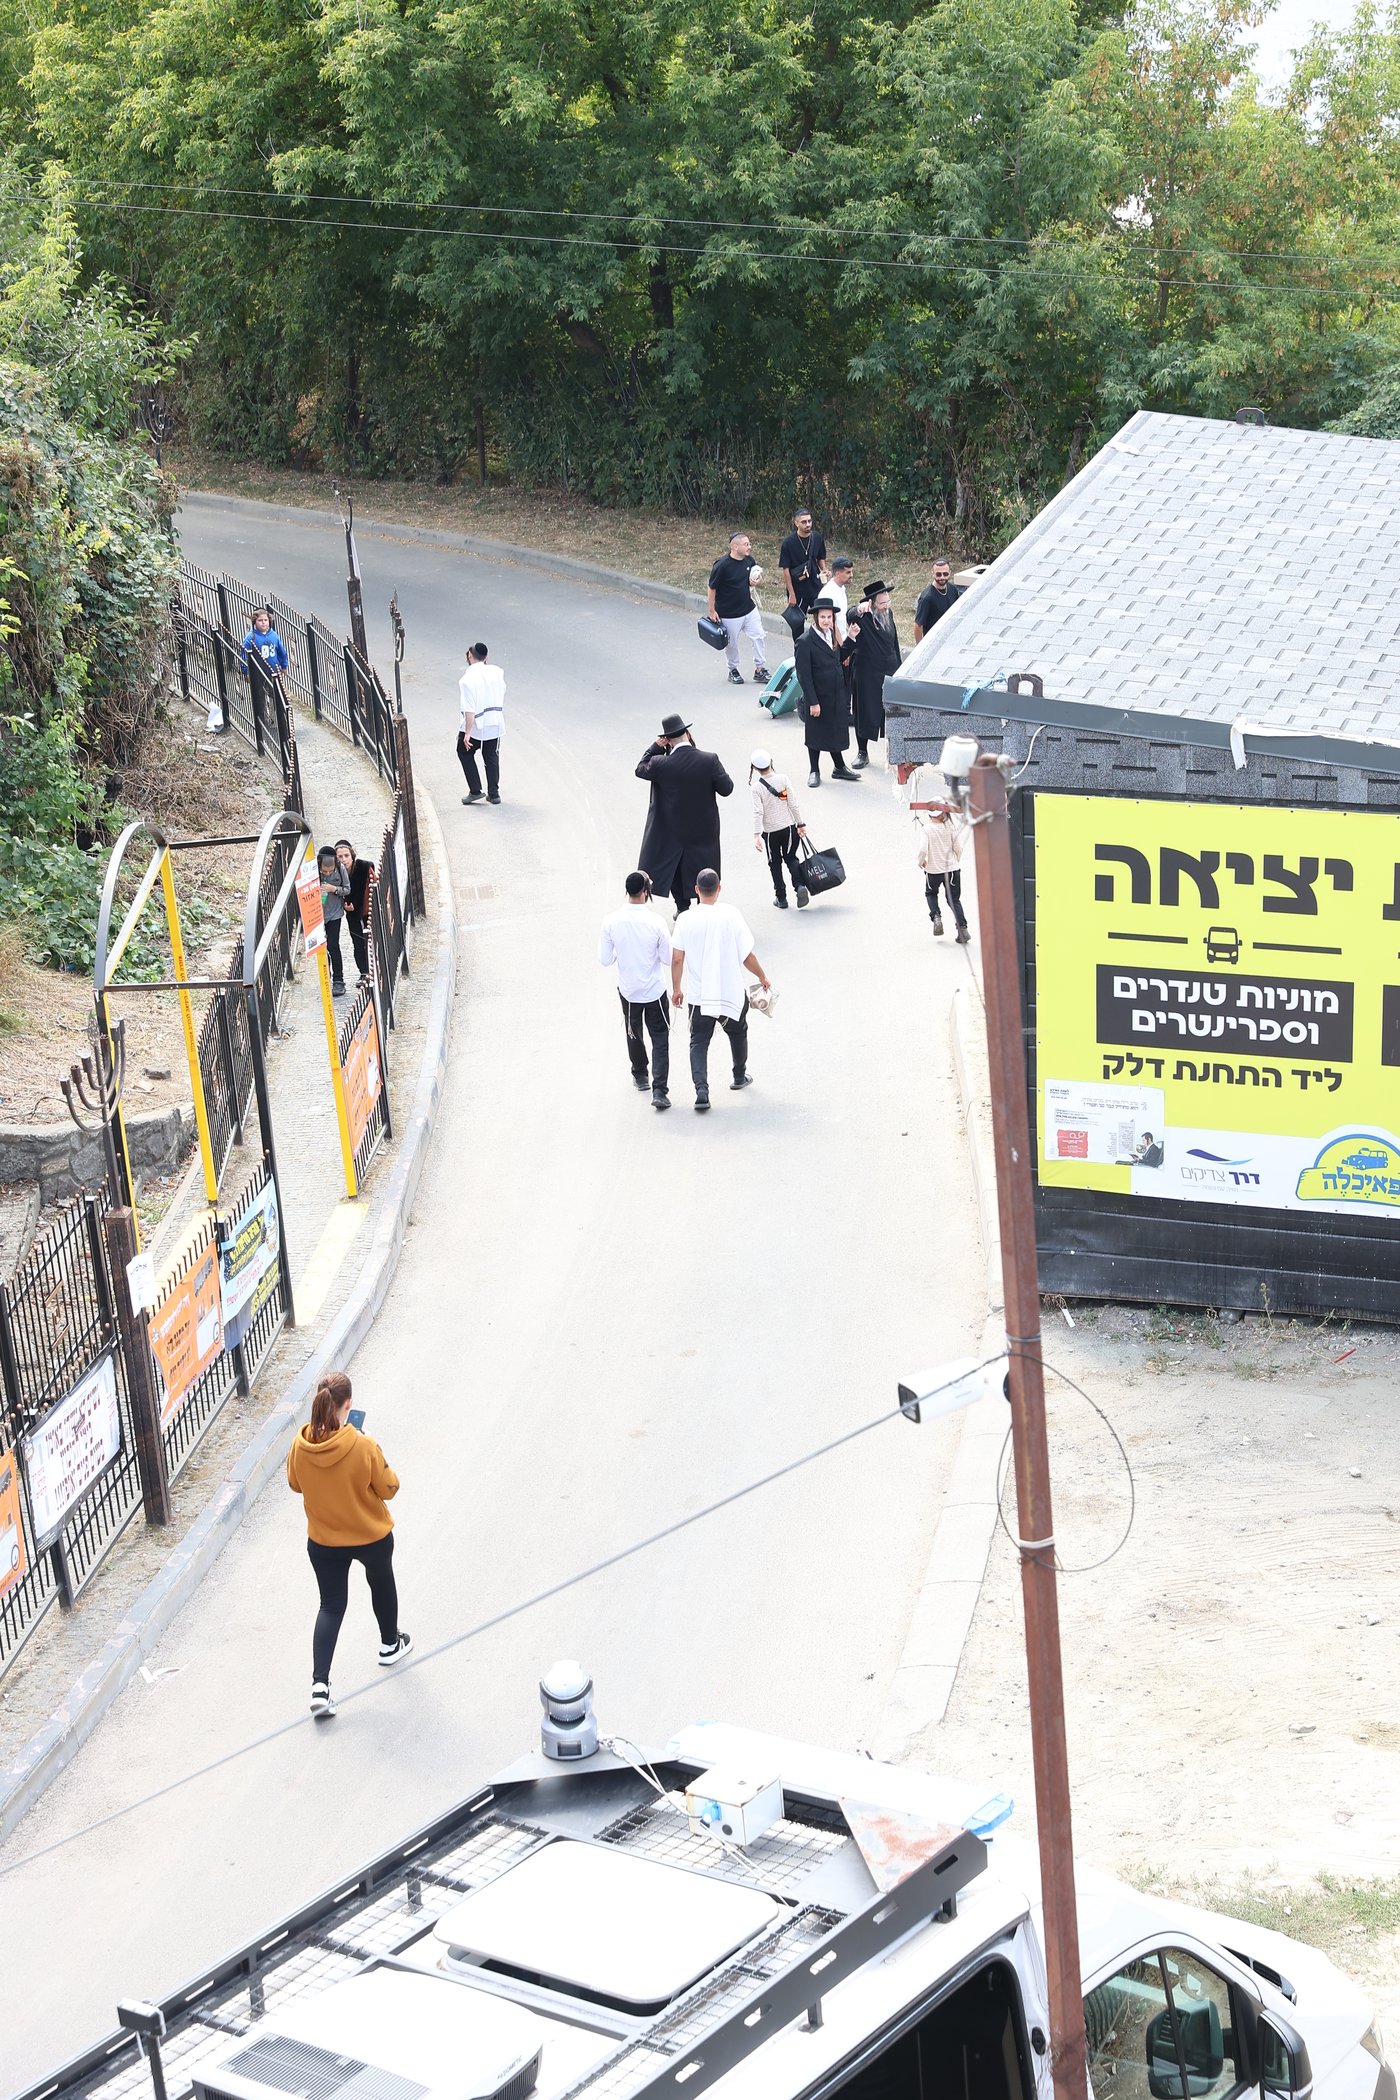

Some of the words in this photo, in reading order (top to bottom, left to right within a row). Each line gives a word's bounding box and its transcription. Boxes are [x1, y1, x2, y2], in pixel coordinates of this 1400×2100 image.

[808, 864, 826, 877] MELI
[1094, 843, 1354, 916] יציאה
[302, 893, 315, 902] אזור
[1113, 975, 1226, 1005] טנדרים
[1236, 985, 1340, 1014] מוניות
[1131, 1008, 1320, 1045] וספרינטרים
[1102, 1052, 1165, 1079] דלק
[1173, 1060, 1282, 1088] התחנת
[1291, 1067, 1343, 1093] ליד
[1180, 1166, 1226, 1182] צדיקים
[1228, 1171, 1260, 1185] דרך
